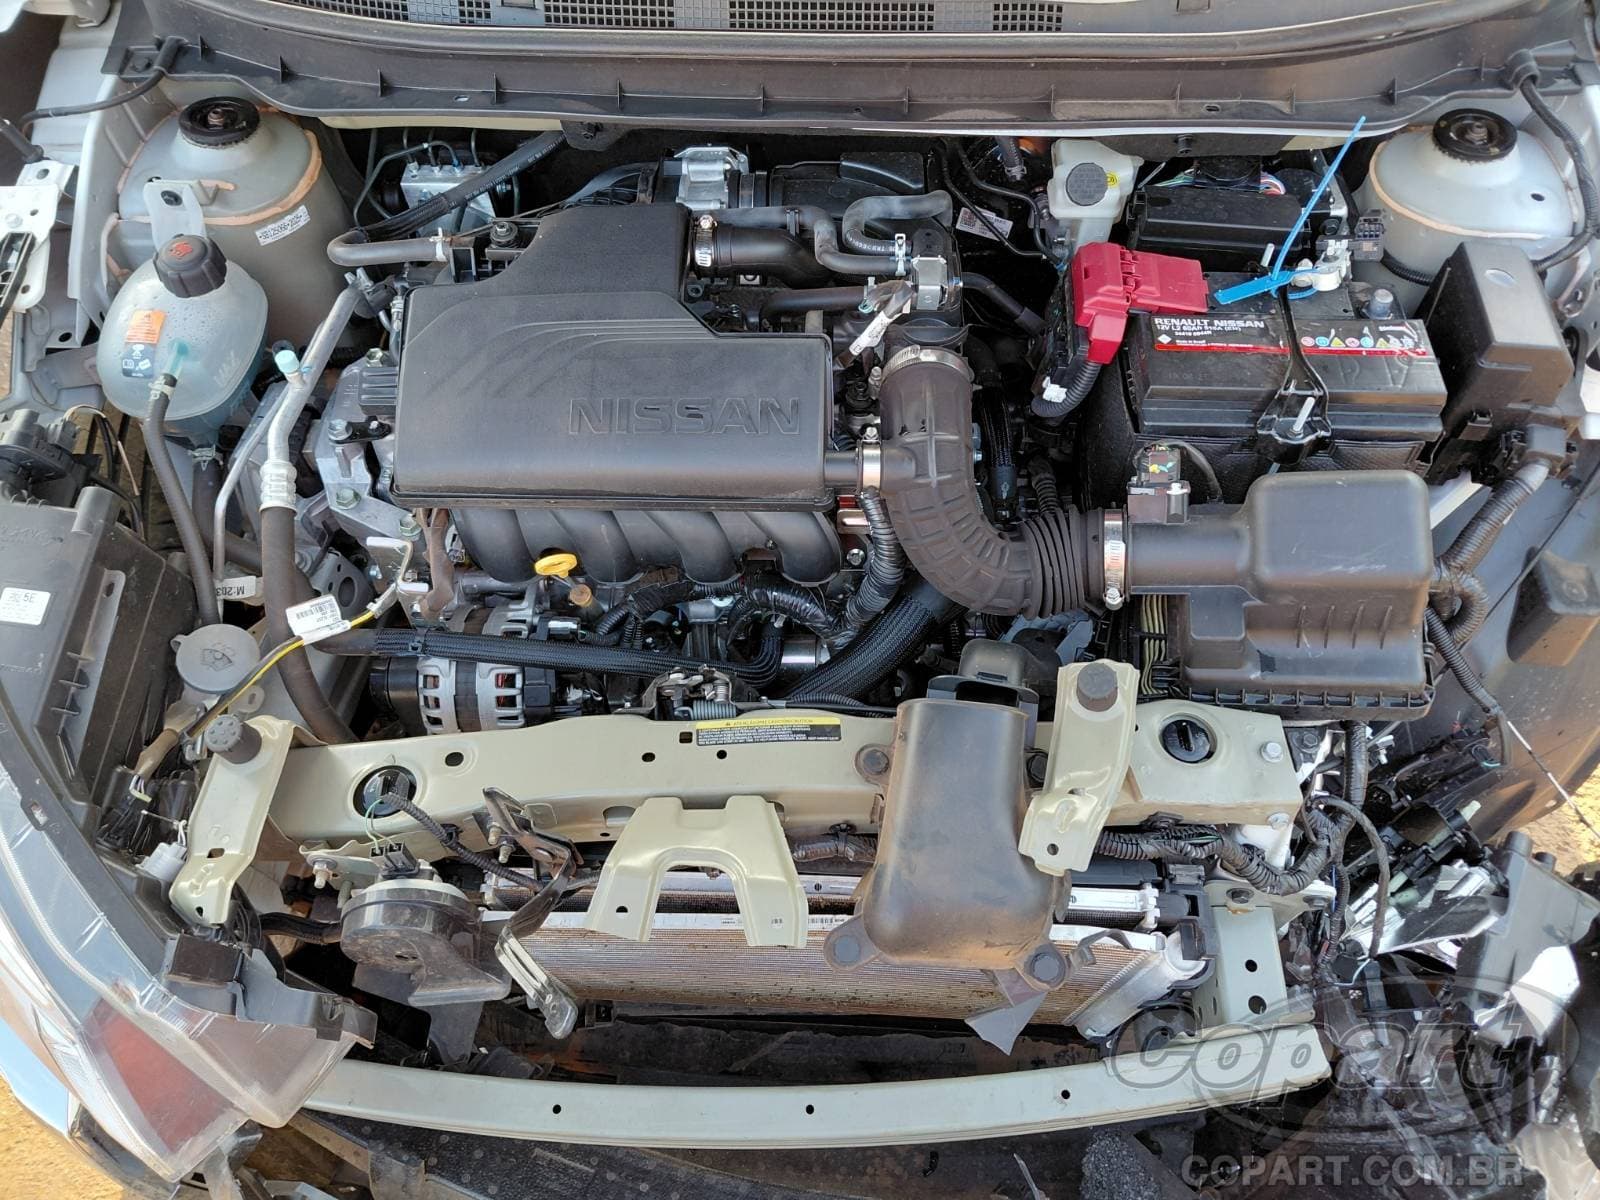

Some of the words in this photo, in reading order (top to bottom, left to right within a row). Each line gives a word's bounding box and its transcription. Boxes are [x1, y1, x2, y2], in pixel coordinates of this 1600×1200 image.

[1154, 318, 1210, 326] RENAULT
[1214, 320, 1265, 328] NISSAN
[568, 398, 802, 435] NISSAN
